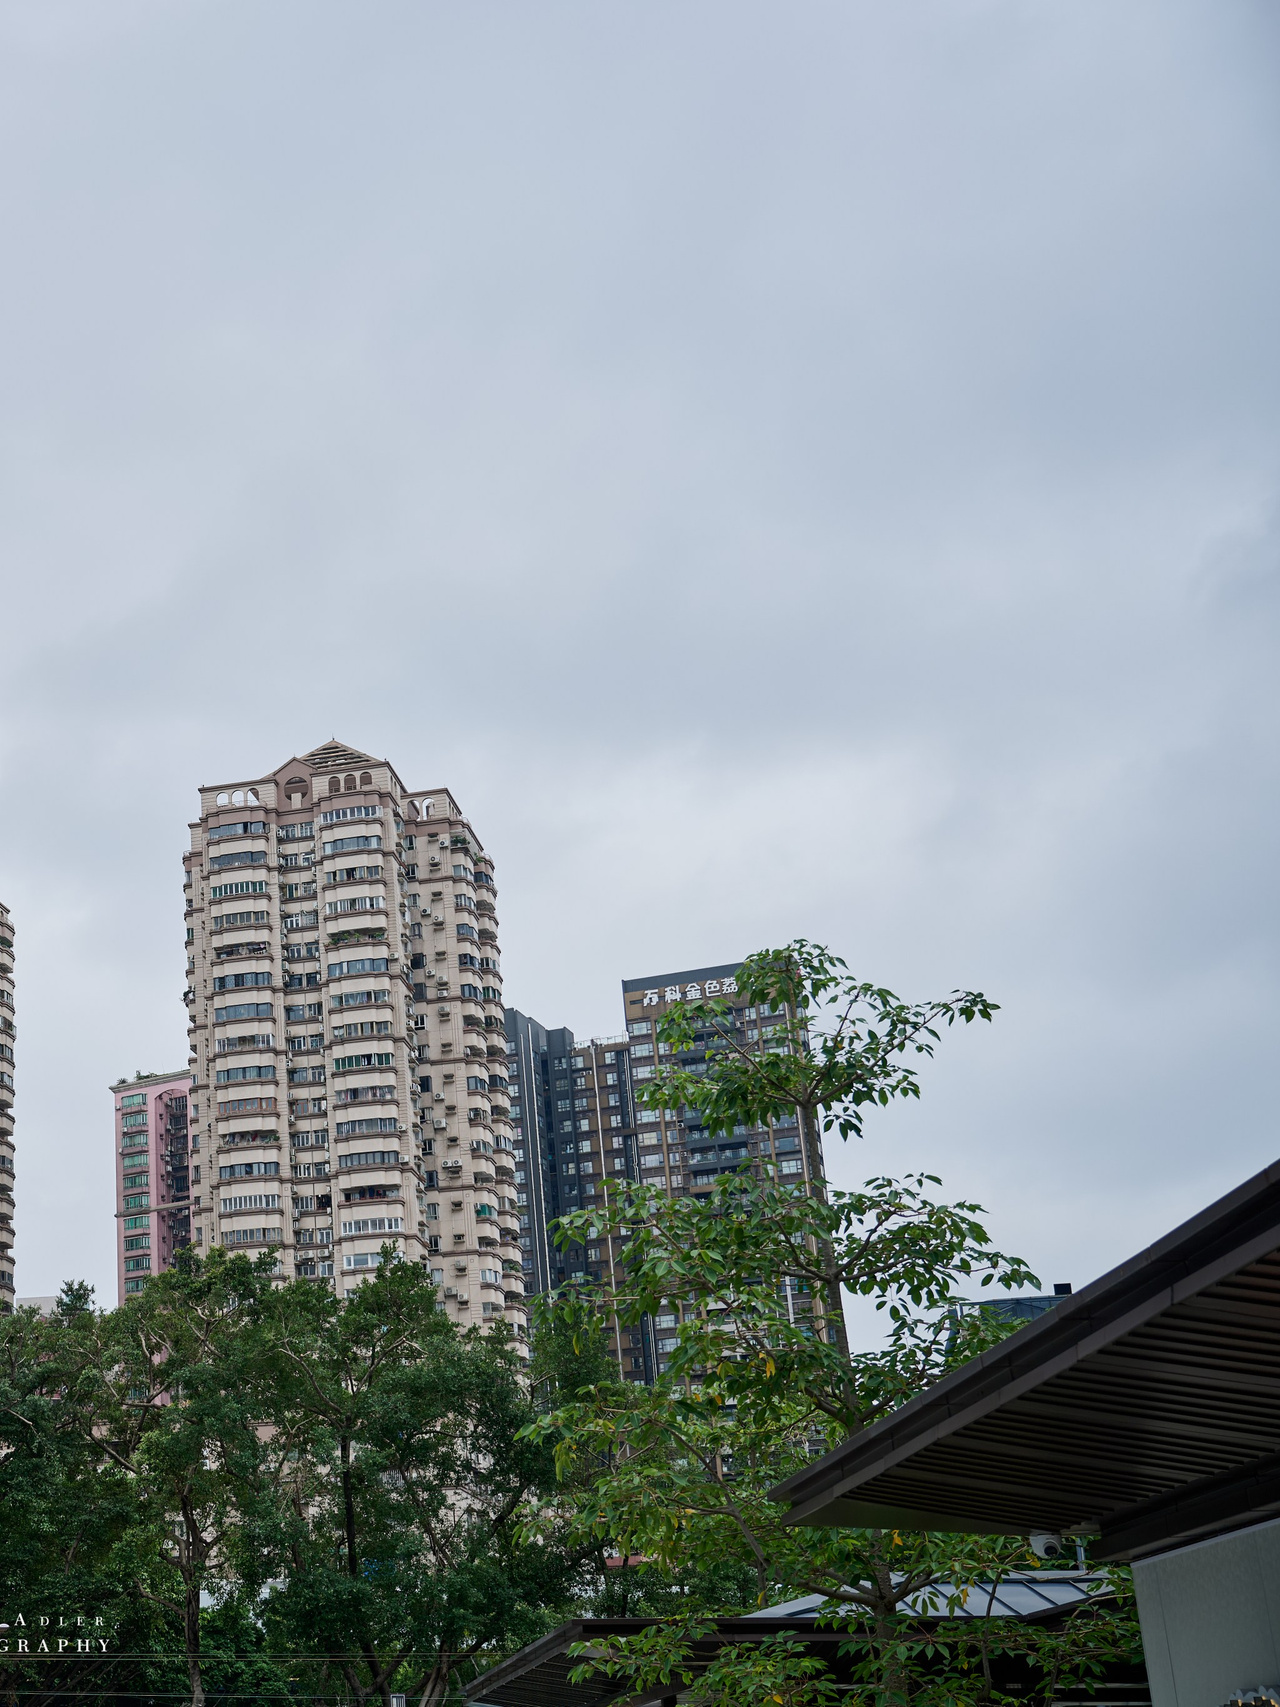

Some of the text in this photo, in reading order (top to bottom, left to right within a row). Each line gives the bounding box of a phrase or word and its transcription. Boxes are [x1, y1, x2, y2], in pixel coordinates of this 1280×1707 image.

[643, 976, 756, 1006] 万科金色荔
